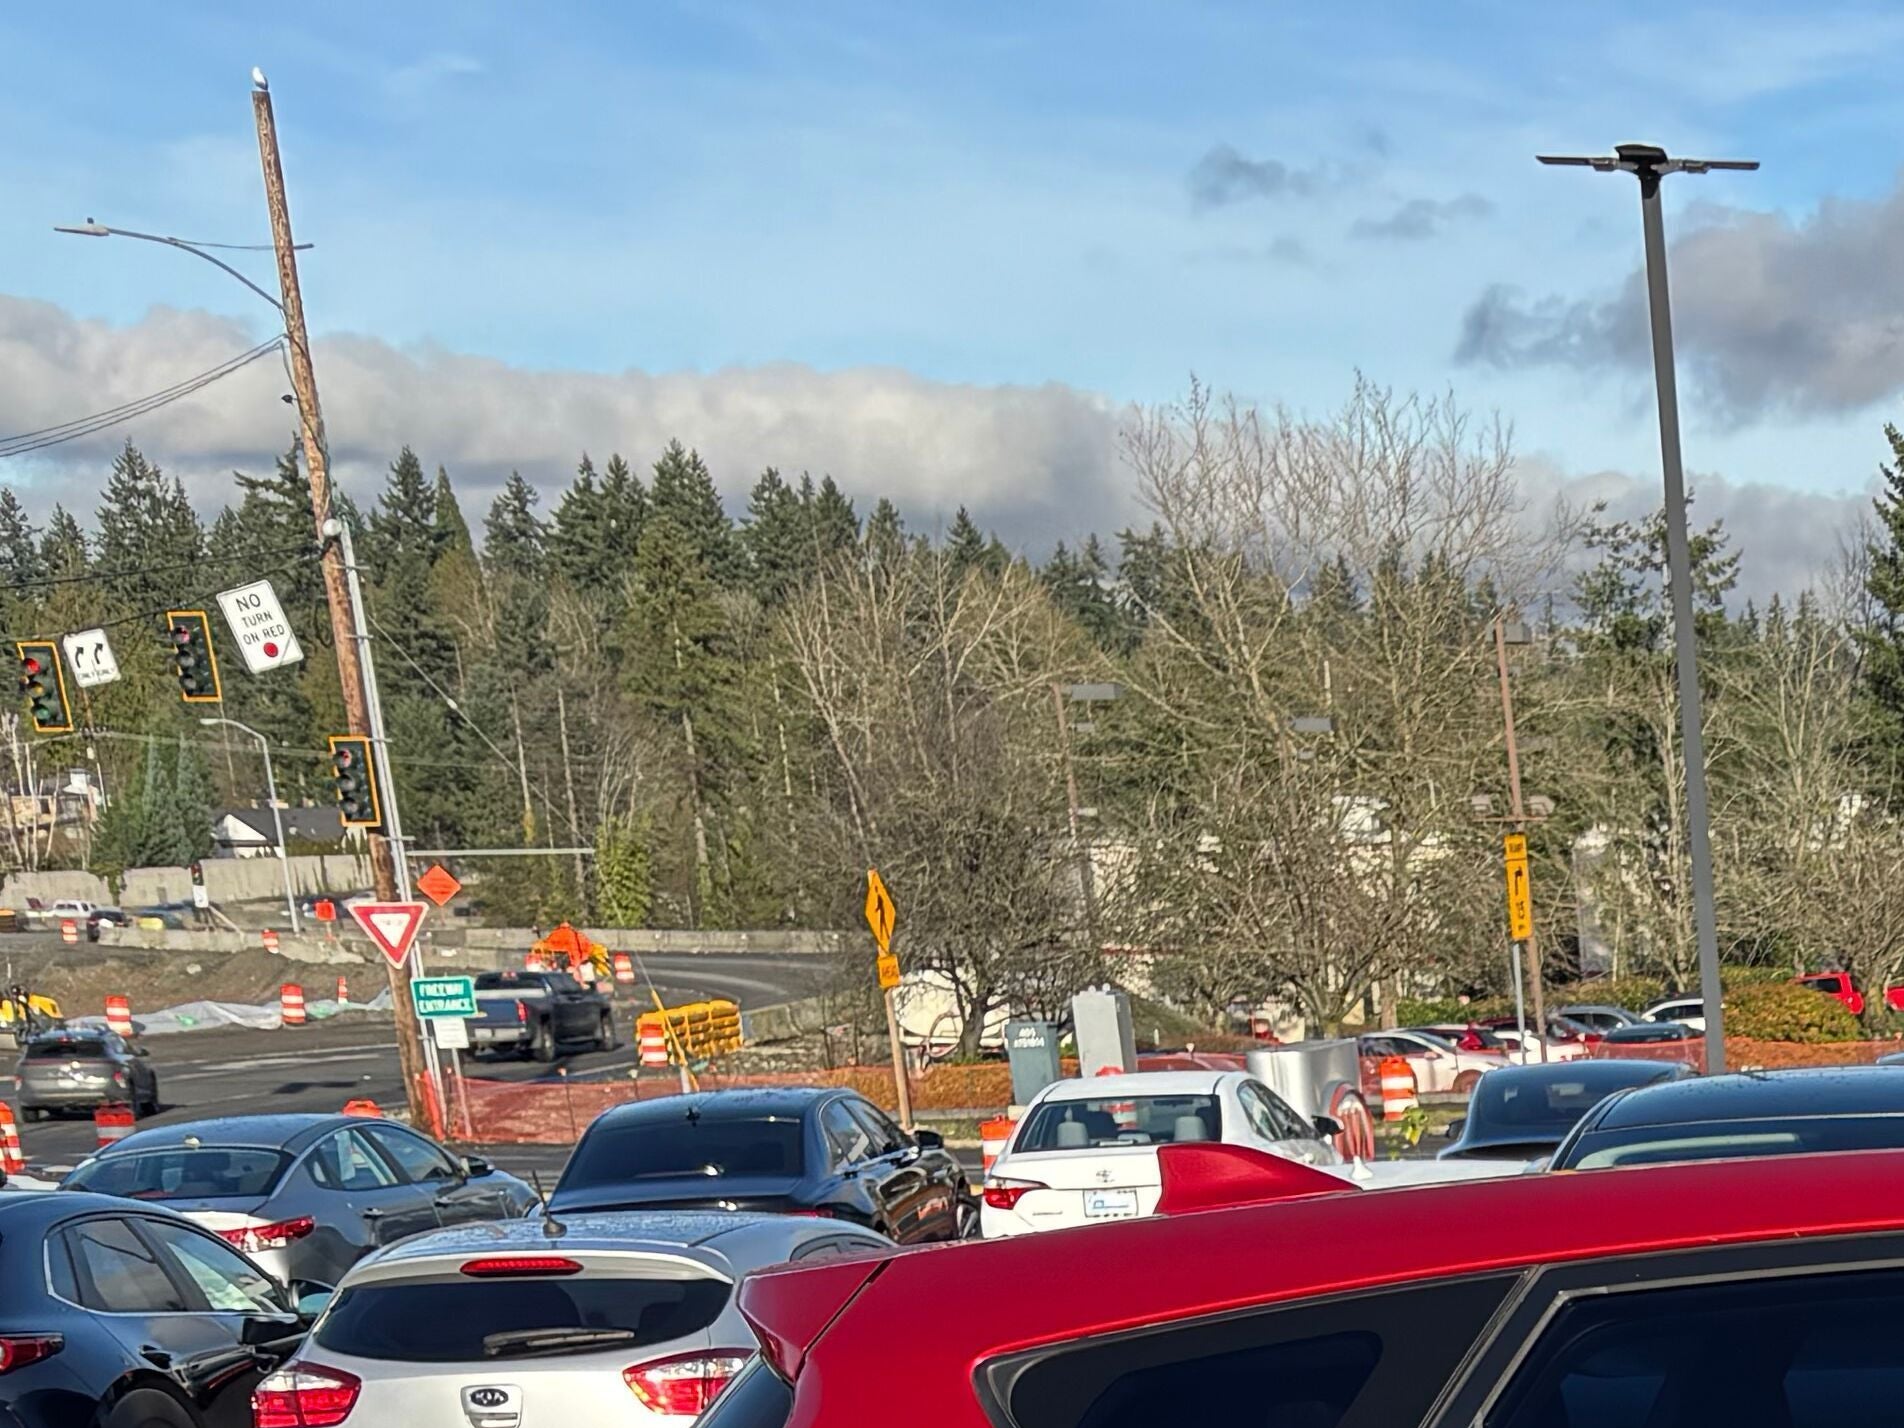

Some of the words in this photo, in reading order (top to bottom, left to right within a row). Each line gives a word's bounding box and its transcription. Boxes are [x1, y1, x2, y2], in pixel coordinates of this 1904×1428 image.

[235, 593, 261, 613] NO
[241, 610, 273, 628] TURN
[242, 632, 261, 646] ON
[262, 624, 285, 639] RED
